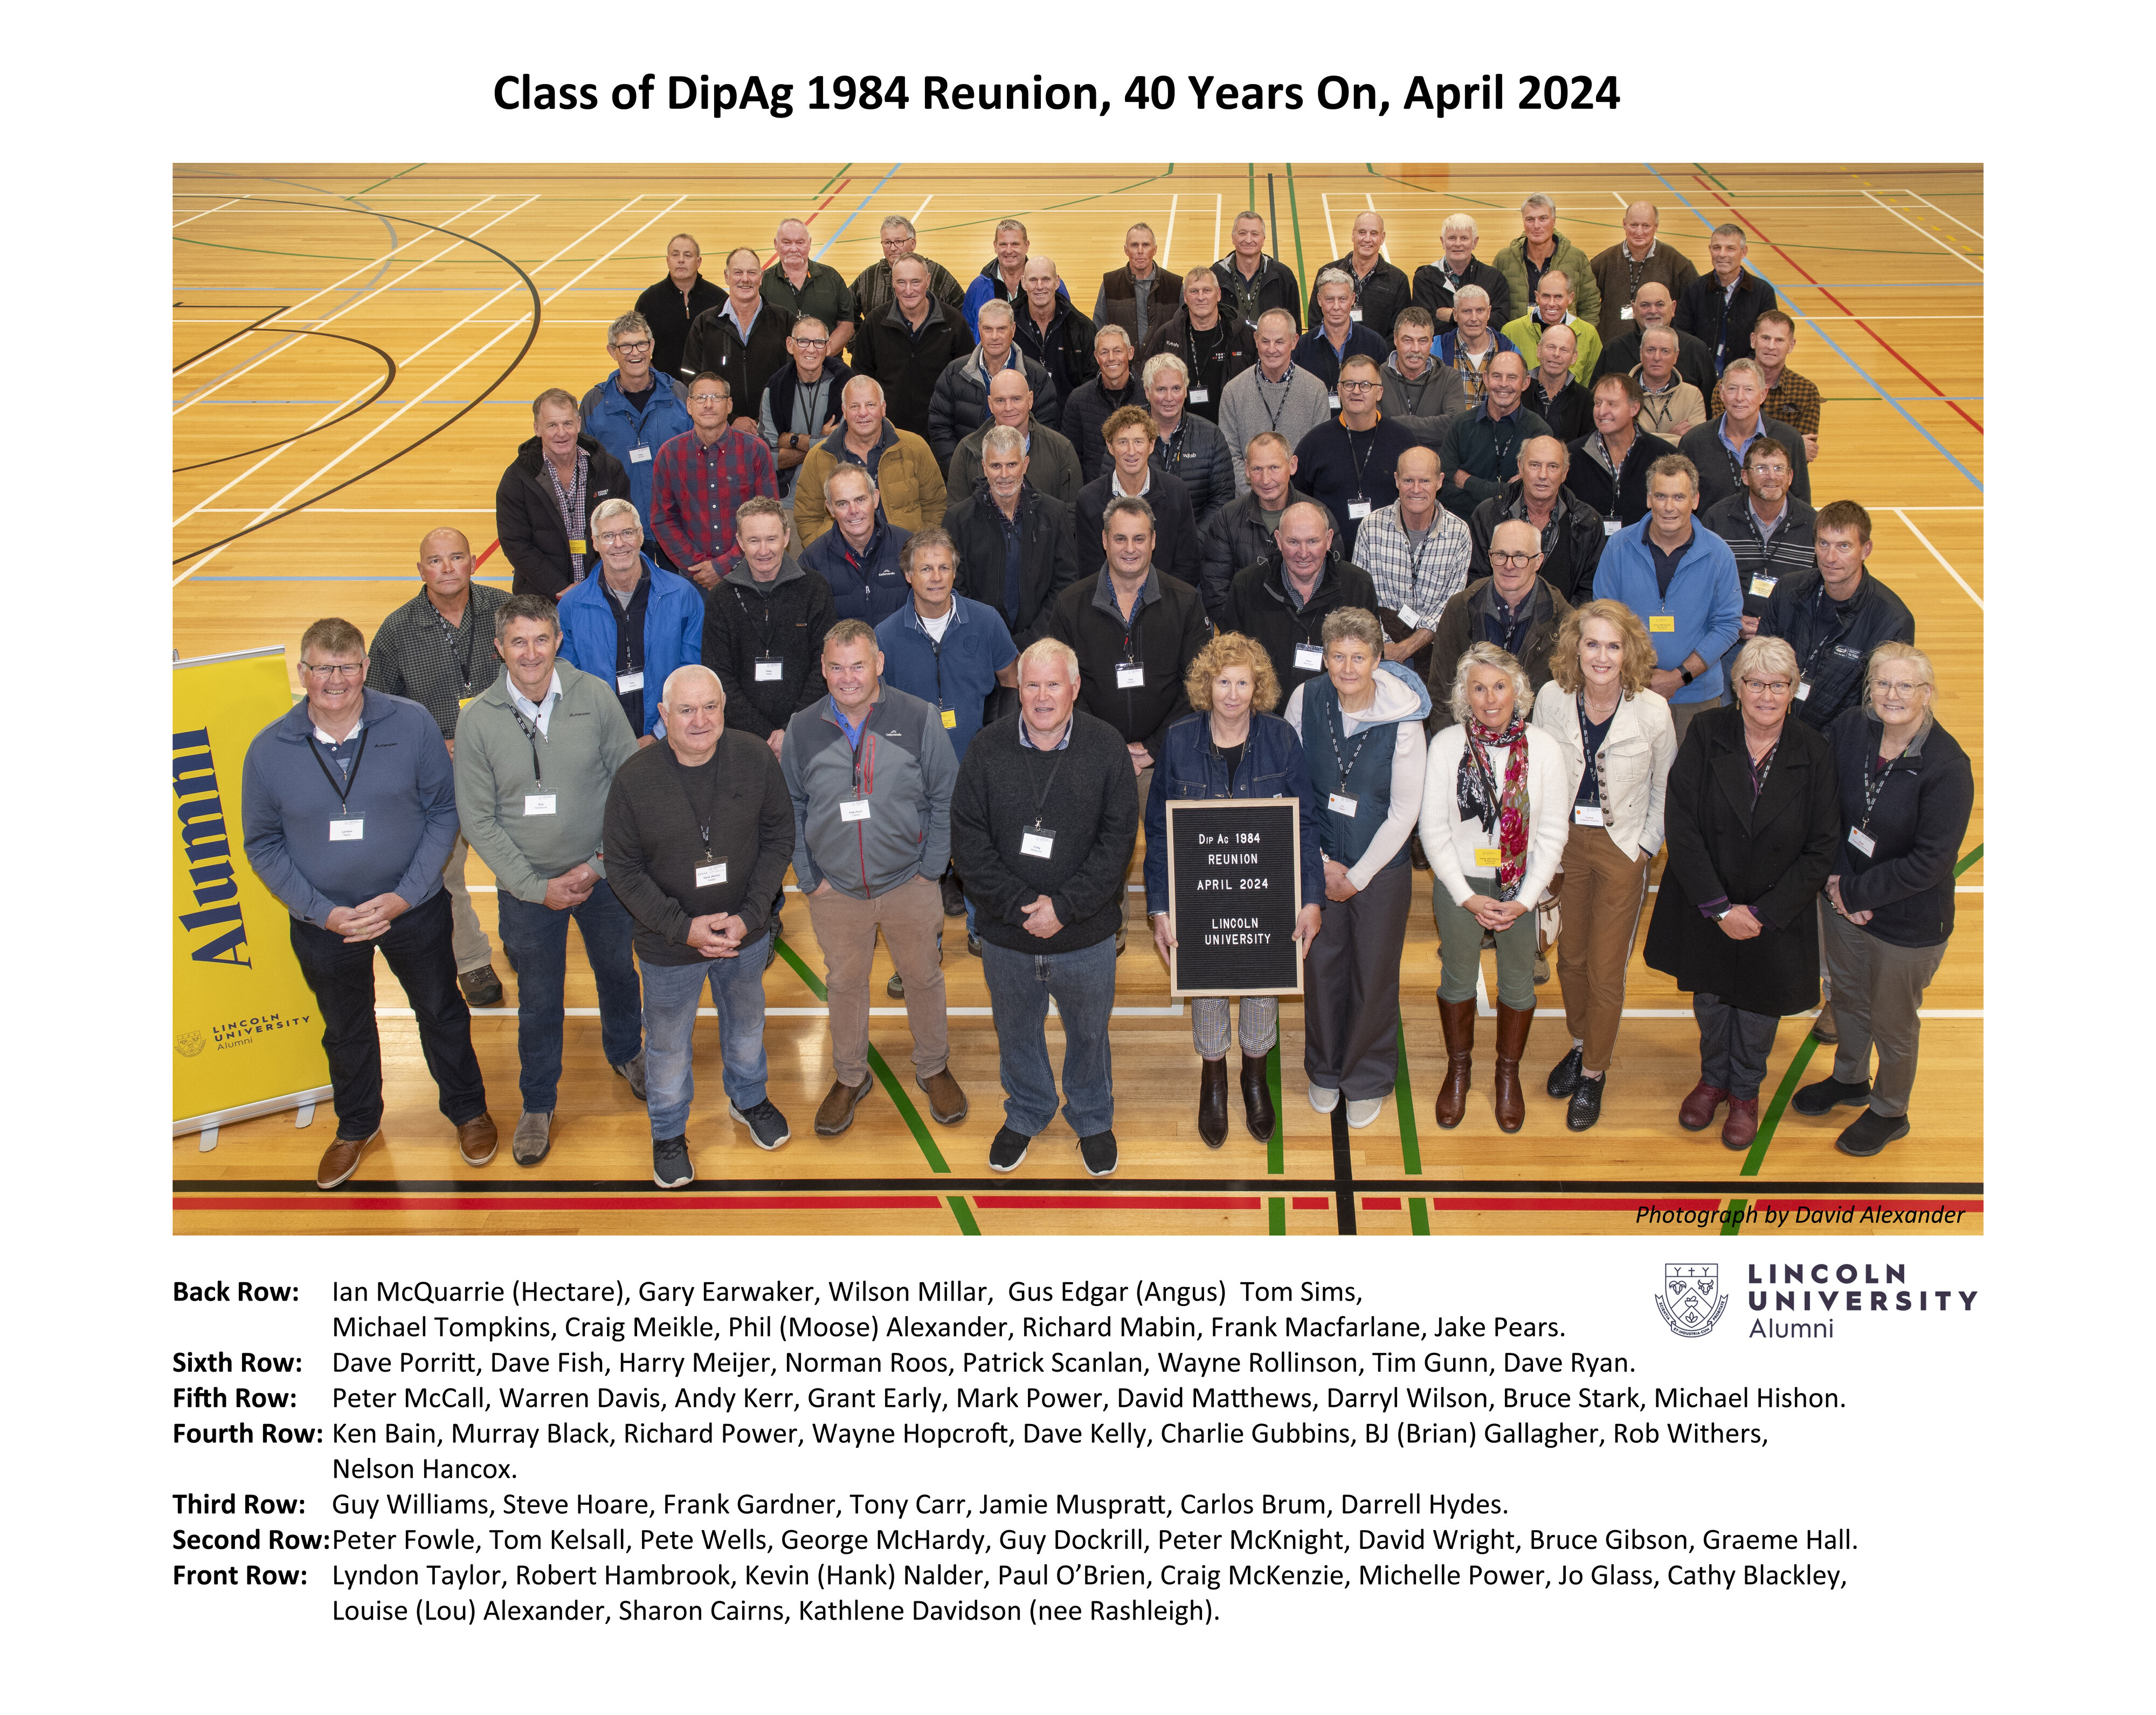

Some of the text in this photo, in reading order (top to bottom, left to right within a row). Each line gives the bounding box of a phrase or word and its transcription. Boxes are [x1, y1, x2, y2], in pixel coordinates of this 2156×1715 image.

[1235, 833, 1261, 843] 1984
[172, 726, 252, 970] Alumni
[1208, 853, 1258, 865] REUNION
[1197, 878, 1269, 890] APRIL 2024
[1212, 917, 1259, 929] LINCOLN
[1205, 933, 1271, 945] UNIVERSITY
[212, 1013, 279, 1033] LINCOLN
[215, 1015, 310, 1042] UNIVERSITY
[217, 1036, 253, 1050] Alumni
